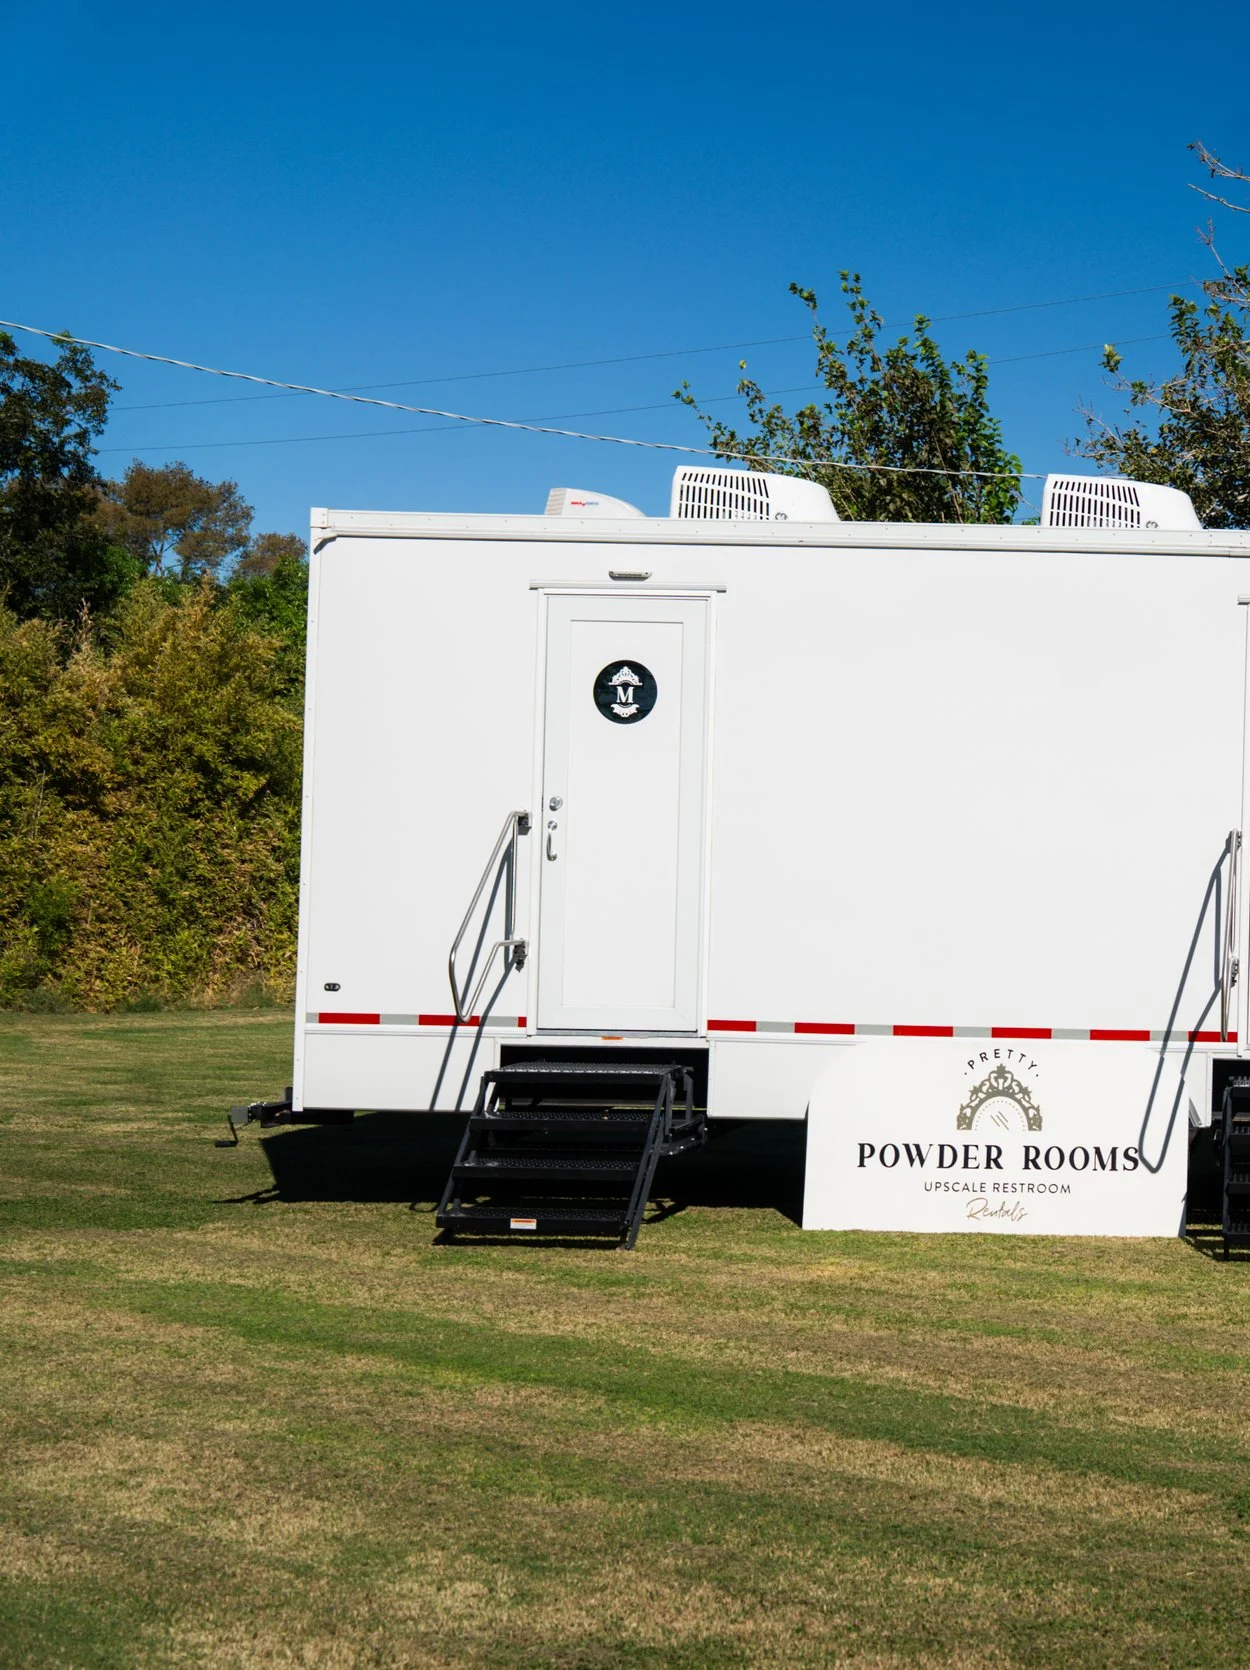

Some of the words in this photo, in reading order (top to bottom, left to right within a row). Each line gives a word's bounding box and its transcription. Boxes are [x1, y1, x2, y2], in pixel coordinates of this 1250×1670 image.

[616, 686, 635, 703] M
[967, 1048, 1037, 1070] PRETTY
[857, 1143, 1004, 1170] POWDER
[1022, 1145, 1139, 1172] ROOMS
[924, 1181, 986, 1193] UPSCALE
[992, 1182, 1071, 1194] RESTROOM
[966, 1197, 1028, 1222] Rentals
